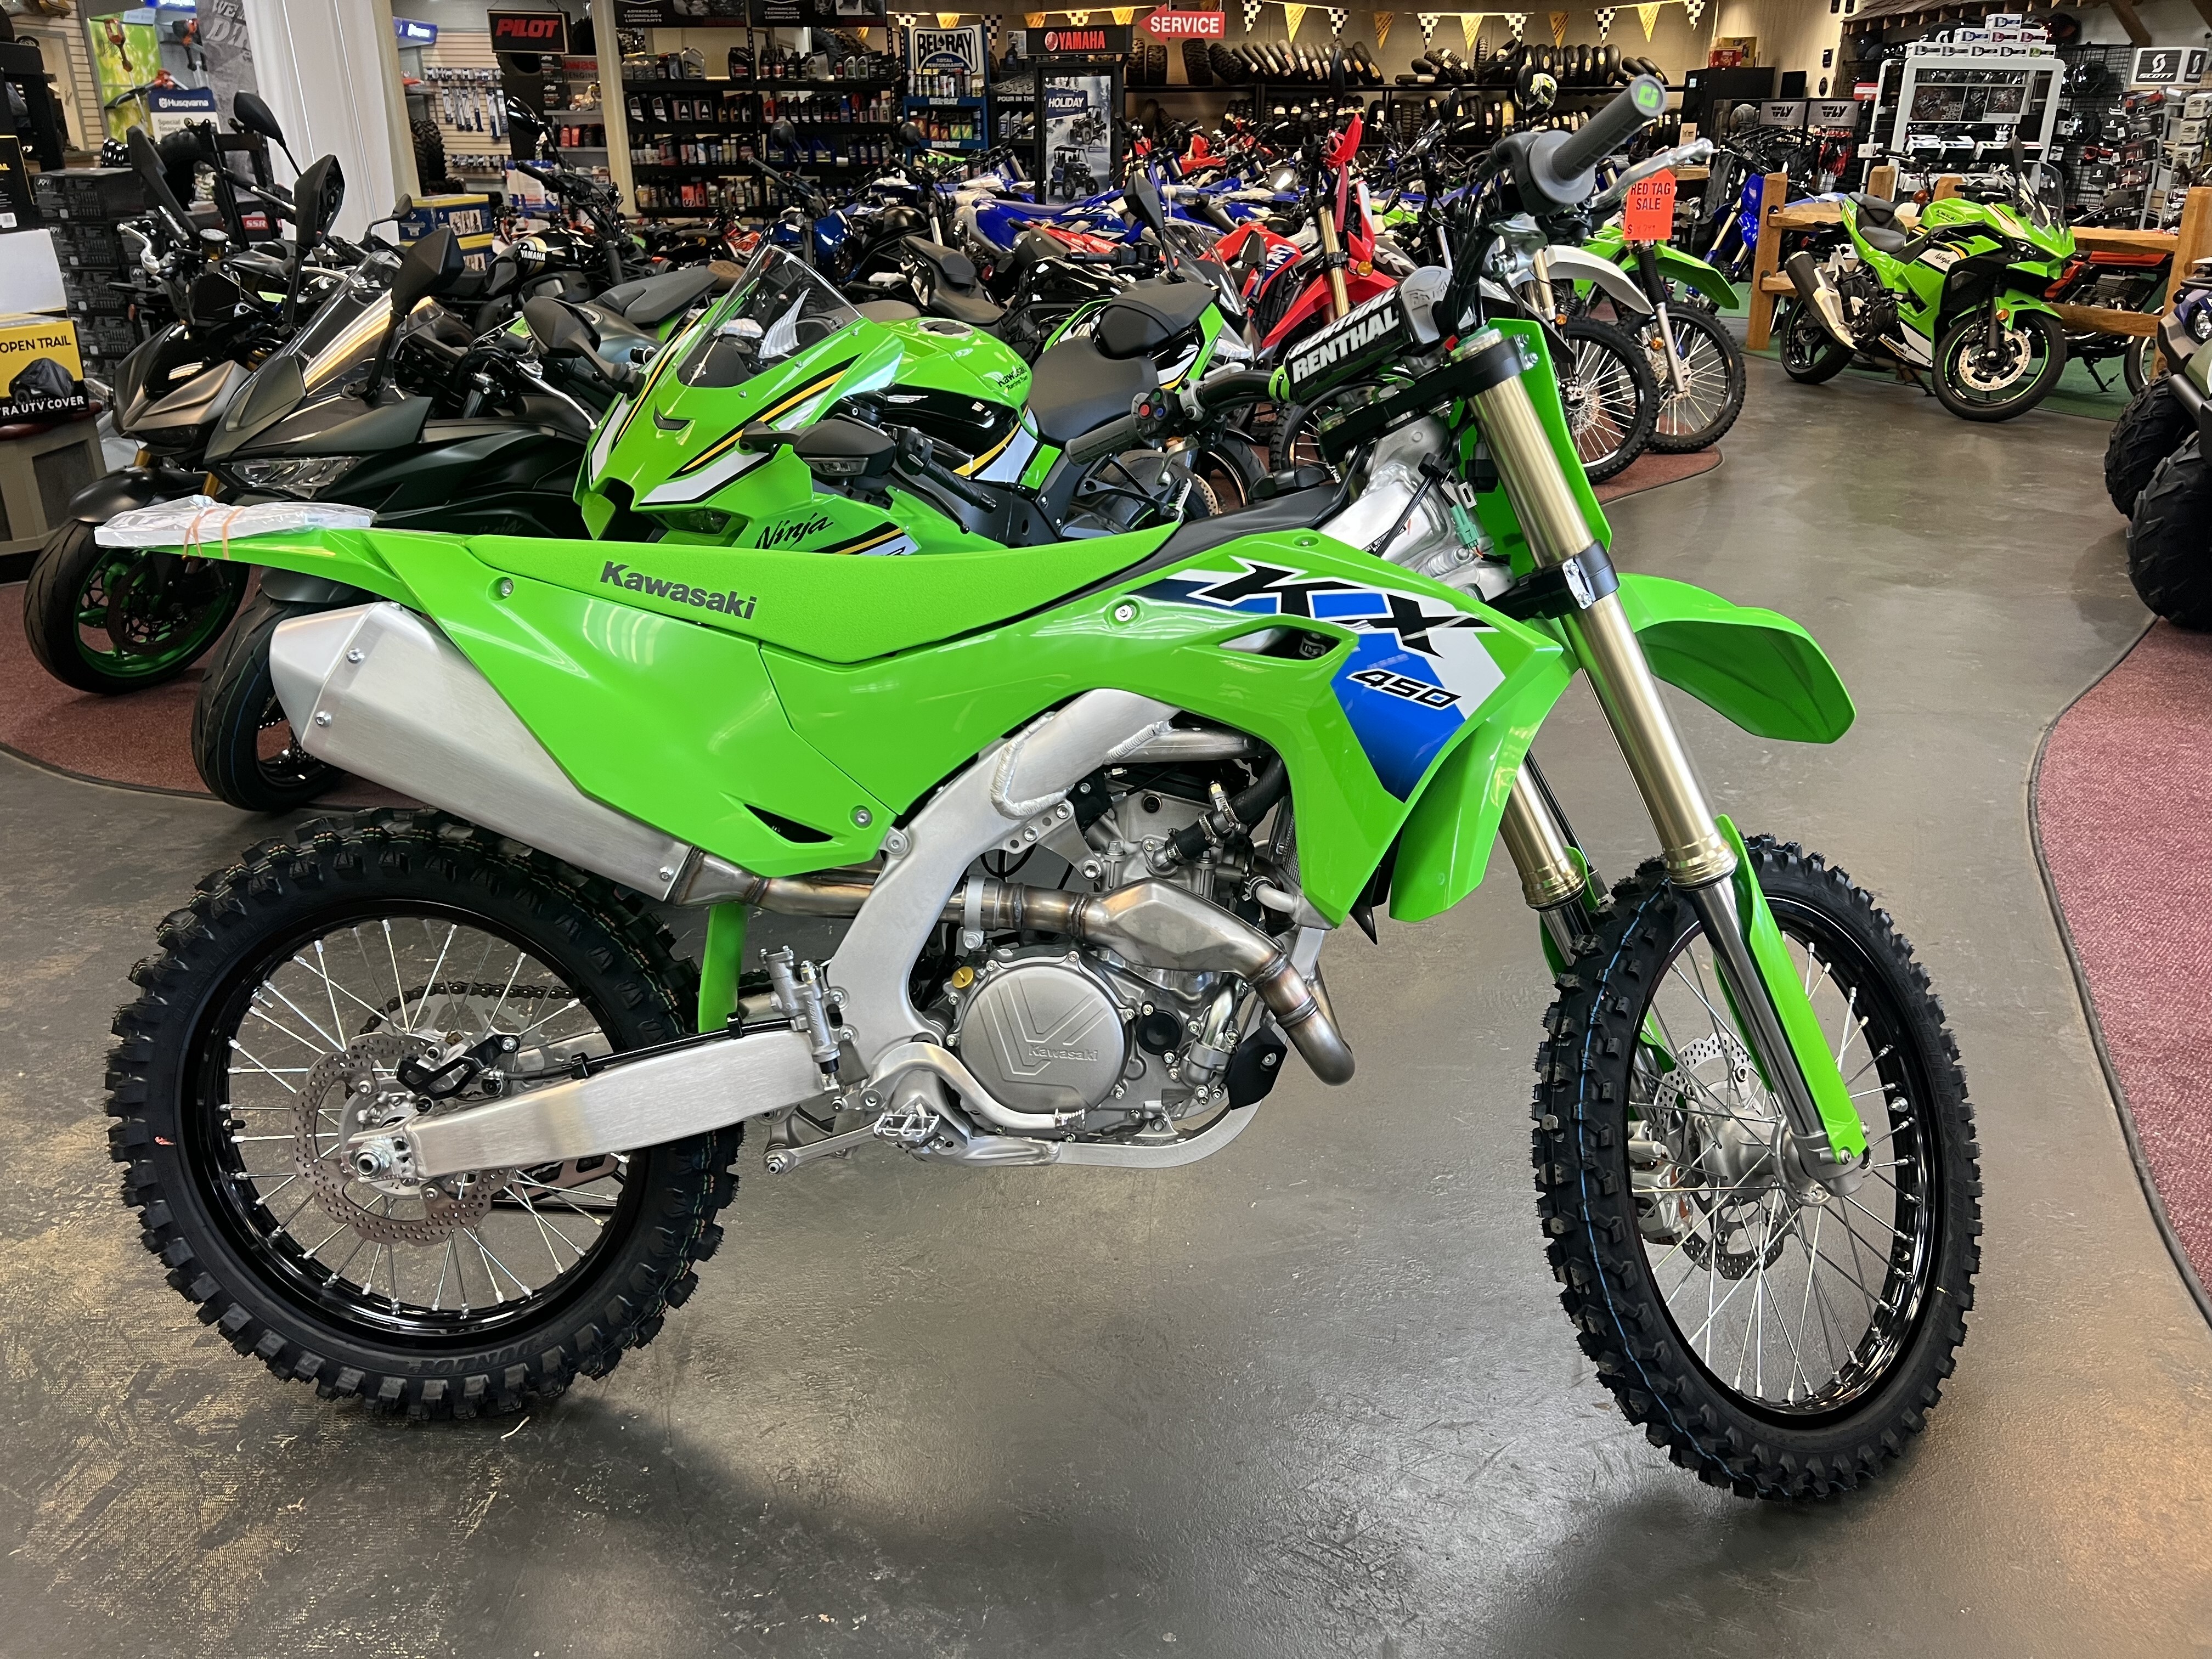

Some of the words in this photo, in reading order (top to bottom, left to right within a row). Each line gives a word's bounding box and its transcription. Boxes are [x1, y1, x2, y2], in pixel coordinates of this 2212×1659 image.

[495, 19, 559, 38] PILOT
[1150, 16, 1220, 33] SERVICE
[1058, 30, 1106, 50] YAMAHA
[167, 99, 210, 108] Husqvarna
[1048, 97, 1085, 108] HOLIDAY
[1630, 183, 1649, 195] RED
[1651, 182, 1671, 195] TAG
[1635, 198, 1661, 210] SALE
[246, 219, 266, 228] SSR
[1627, 224, 1633, 235] $
[520, 250, 546, 261] YAMAHA
[1934, 252, 1951, 264] Ninja
[0, 338, 36, 353] OPEN
[37, 335, 72, 349] TRAIL
[1291, 306, 1400, 384] RENTHAL
[0, 405, 20, 416] RA
[21, 401, 45, 414] UTV
[47, 396, 84, 409] COVER
[754, 511, 834, 550] Ninja
[600, 561, 757, 620] Kawasaki
[1187, 556, 1500, 659] KX
[1346, 668, 1462, 710] 450
[1028, 1044, 1099, 1062] Kawasaki
